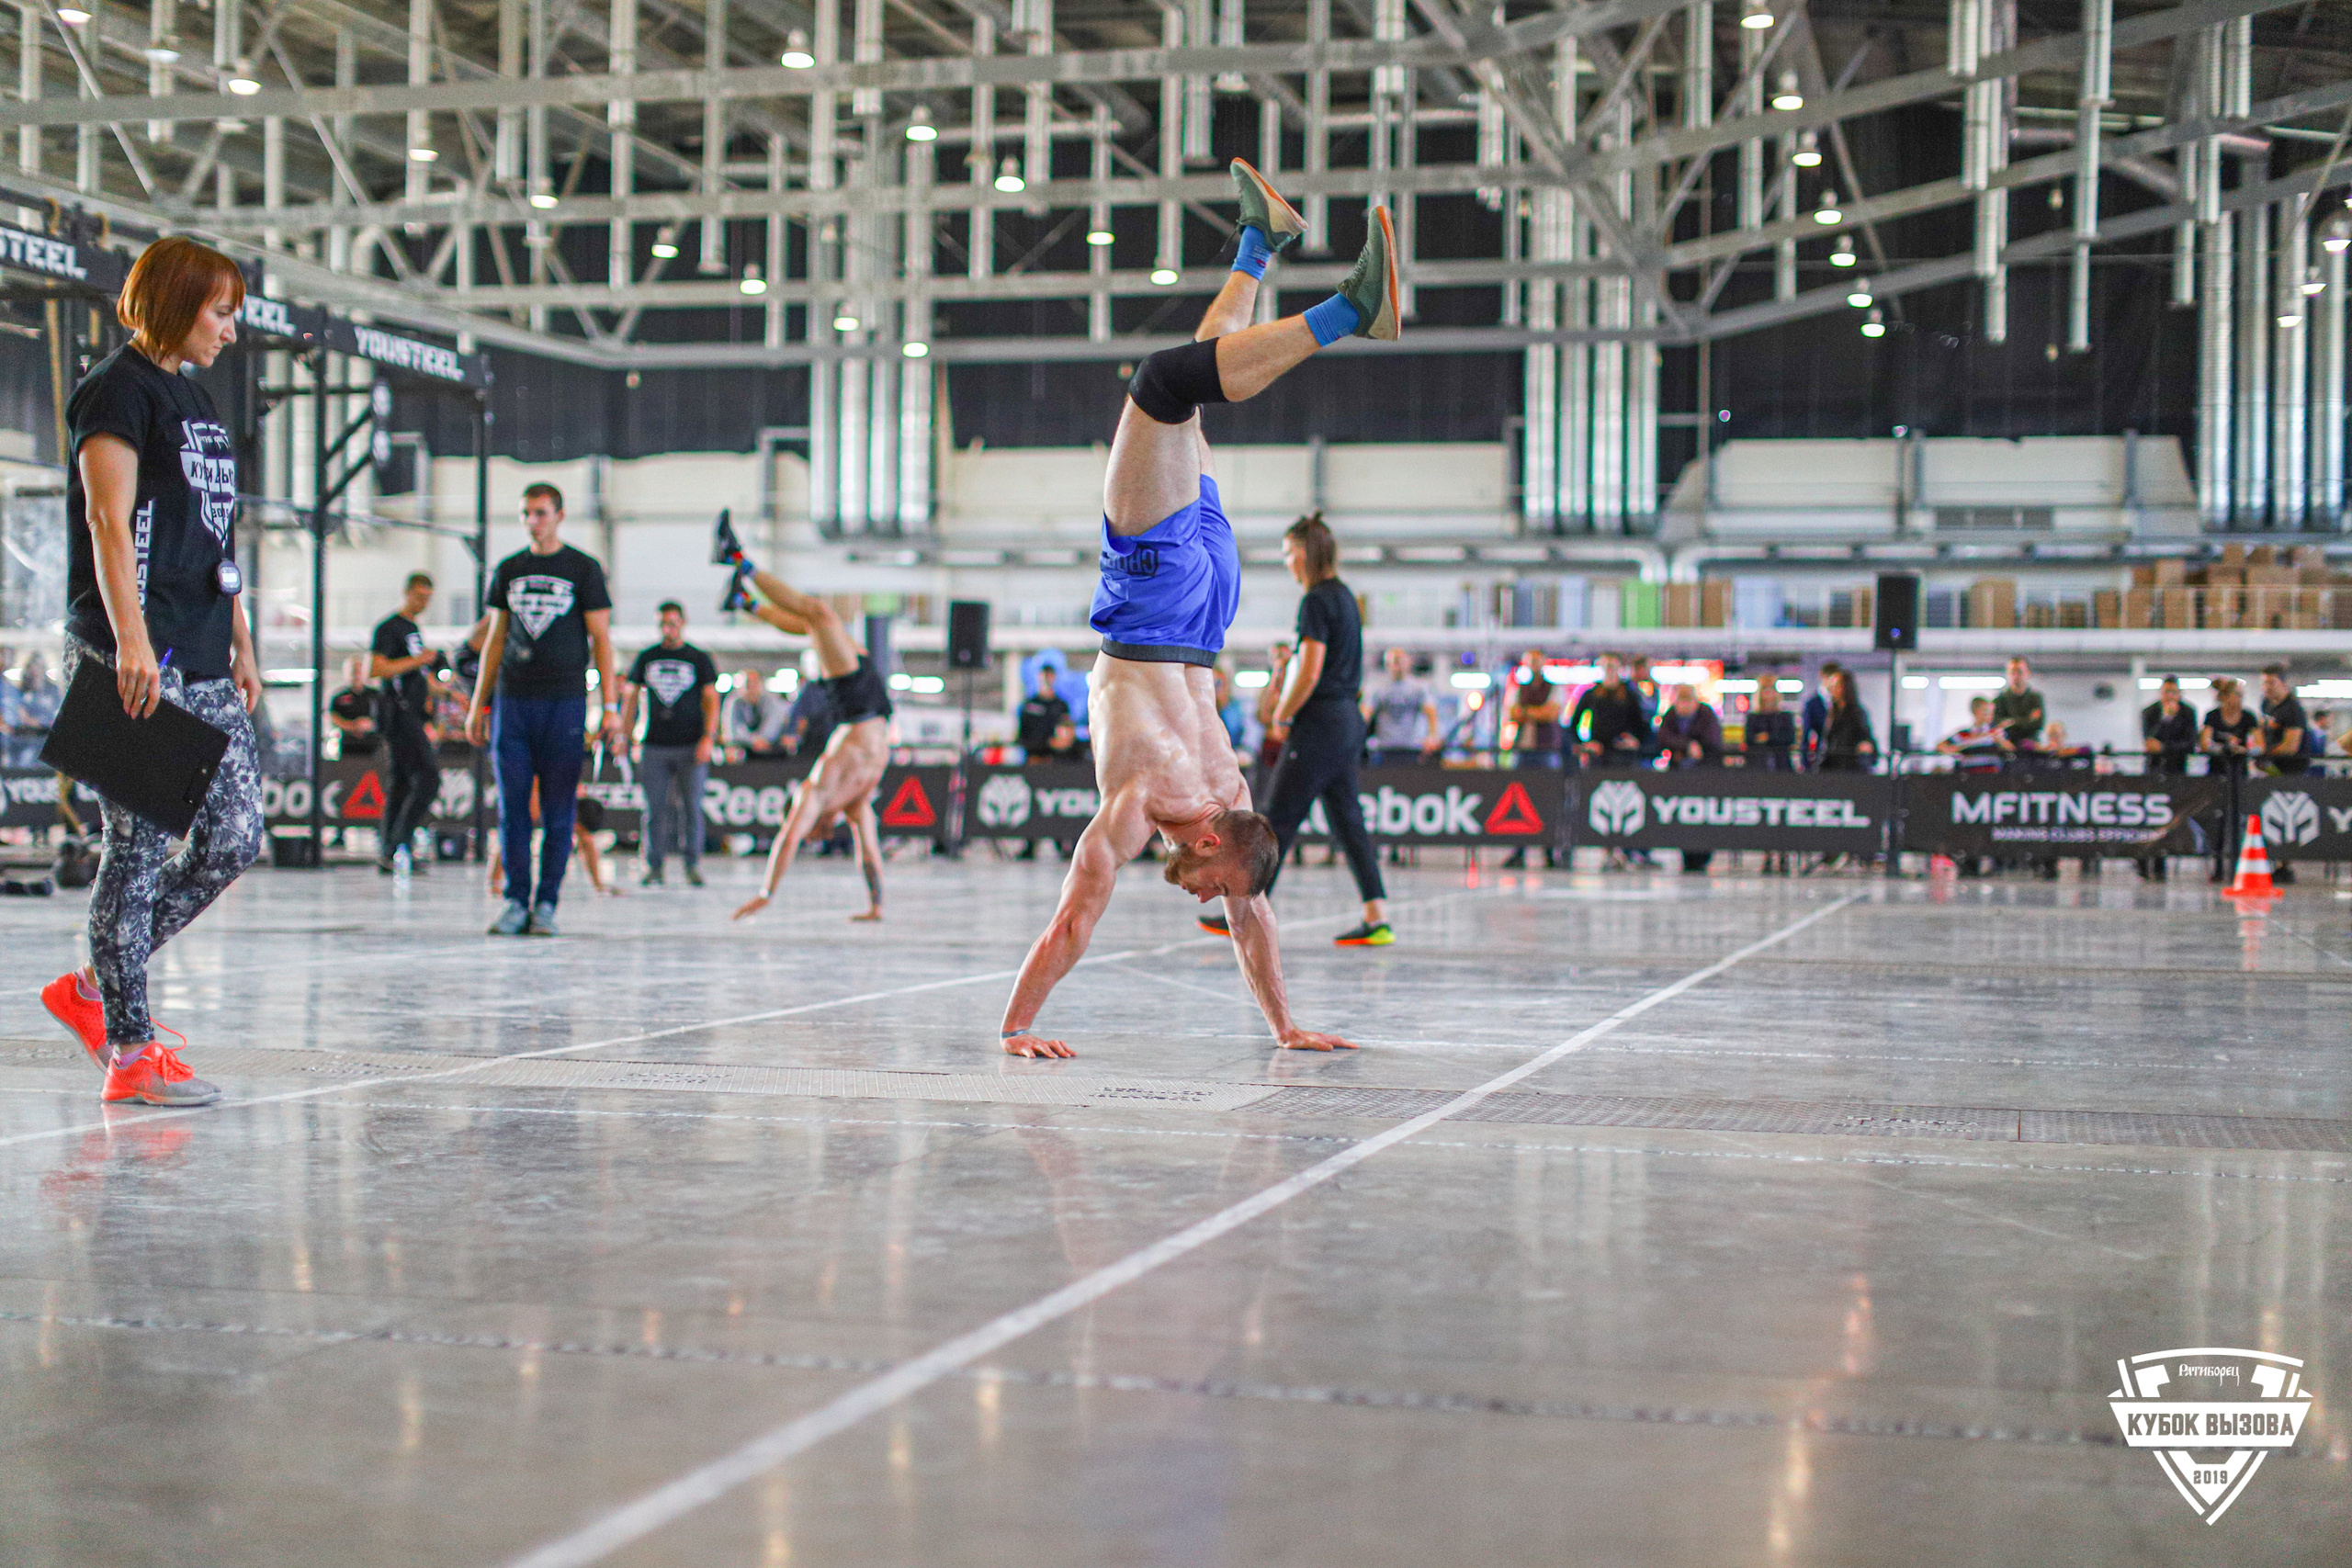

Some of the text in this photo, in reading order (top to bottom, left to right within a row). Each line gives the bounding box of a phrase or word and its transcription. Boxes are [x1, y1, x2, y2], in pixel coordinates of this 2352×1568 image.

[354, 325, 466, 382] YOUSTEEL
[135, 500, 154, 620] OUSTEEL
[1651, 795, 1871, 827] YOUSTEEL
[1951, 791, 2174, 826] MFITNESS
